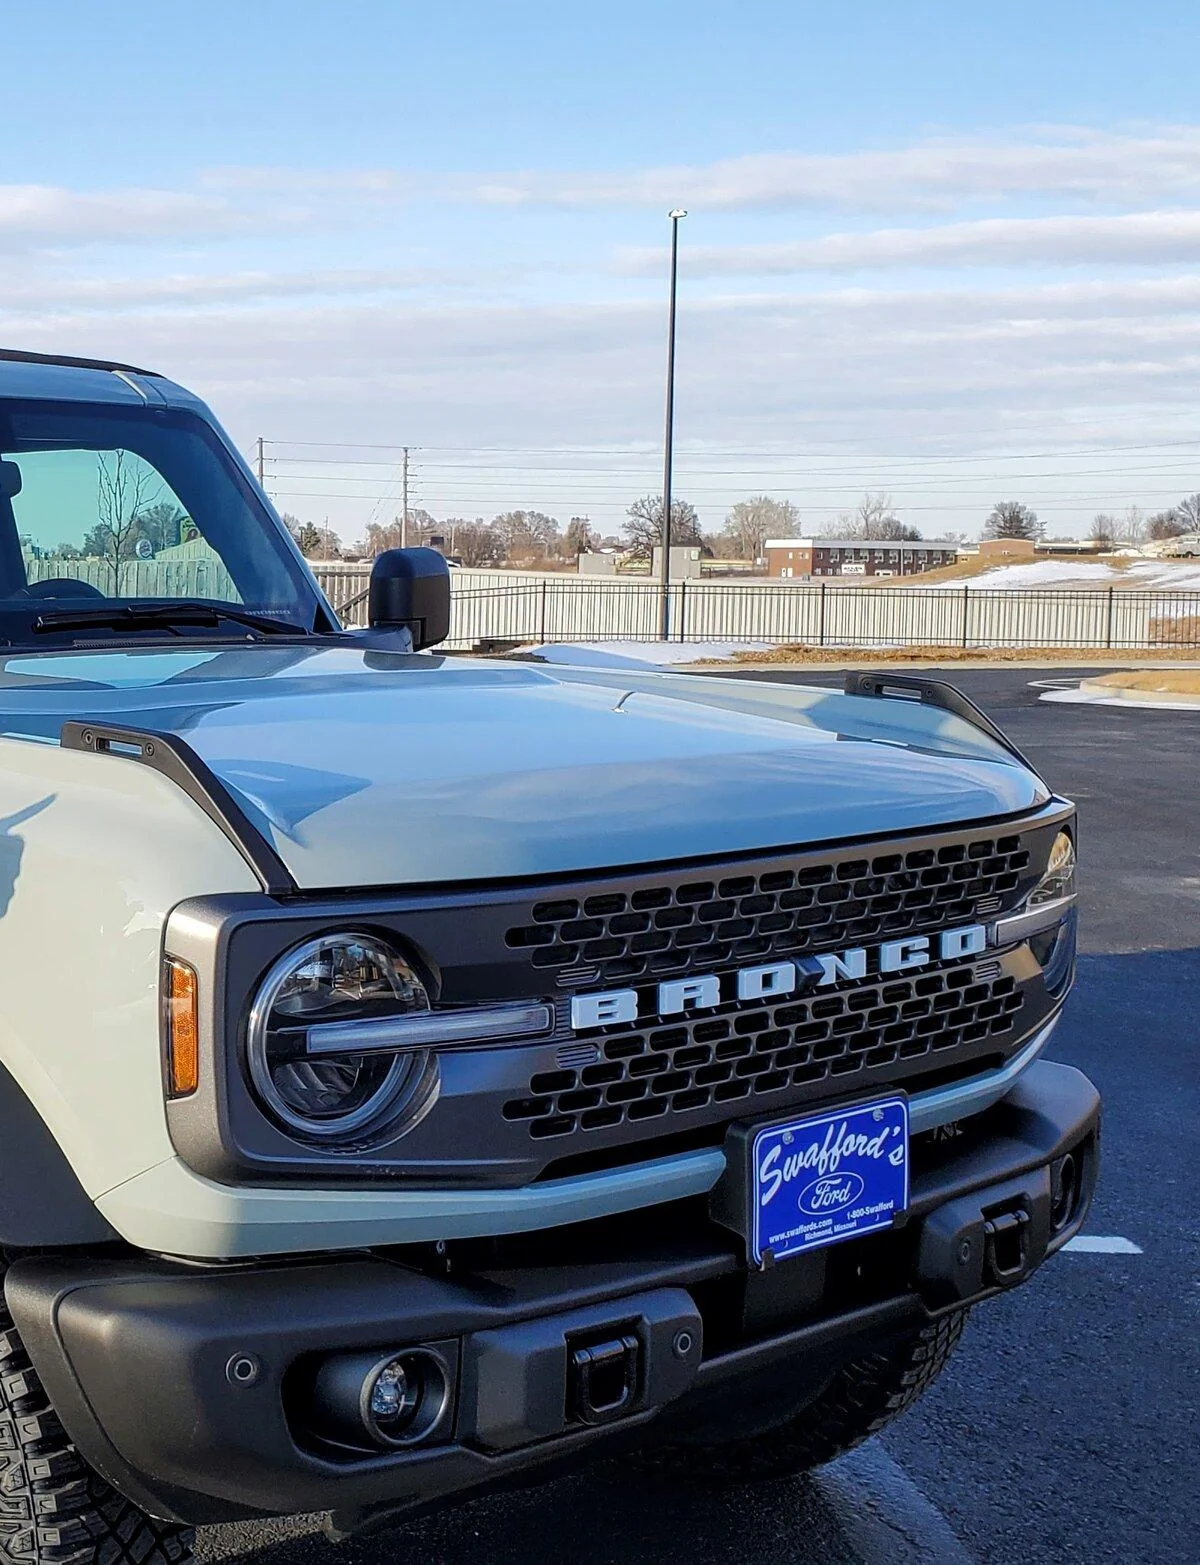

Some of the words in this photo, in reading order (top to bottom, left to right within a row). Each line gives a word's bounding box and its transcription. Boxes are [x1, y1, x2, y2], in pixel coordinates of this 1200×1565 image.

[571, 924, 986, 1030] BRONCO
[760, 1121, 904, 1206] Swafford's
[811, 1178, 852, 1209] Ford
[847, 1200, 894, 1219] 1-800-Swafford
[769, 1218, 833, 1244] www.swaffords.com
